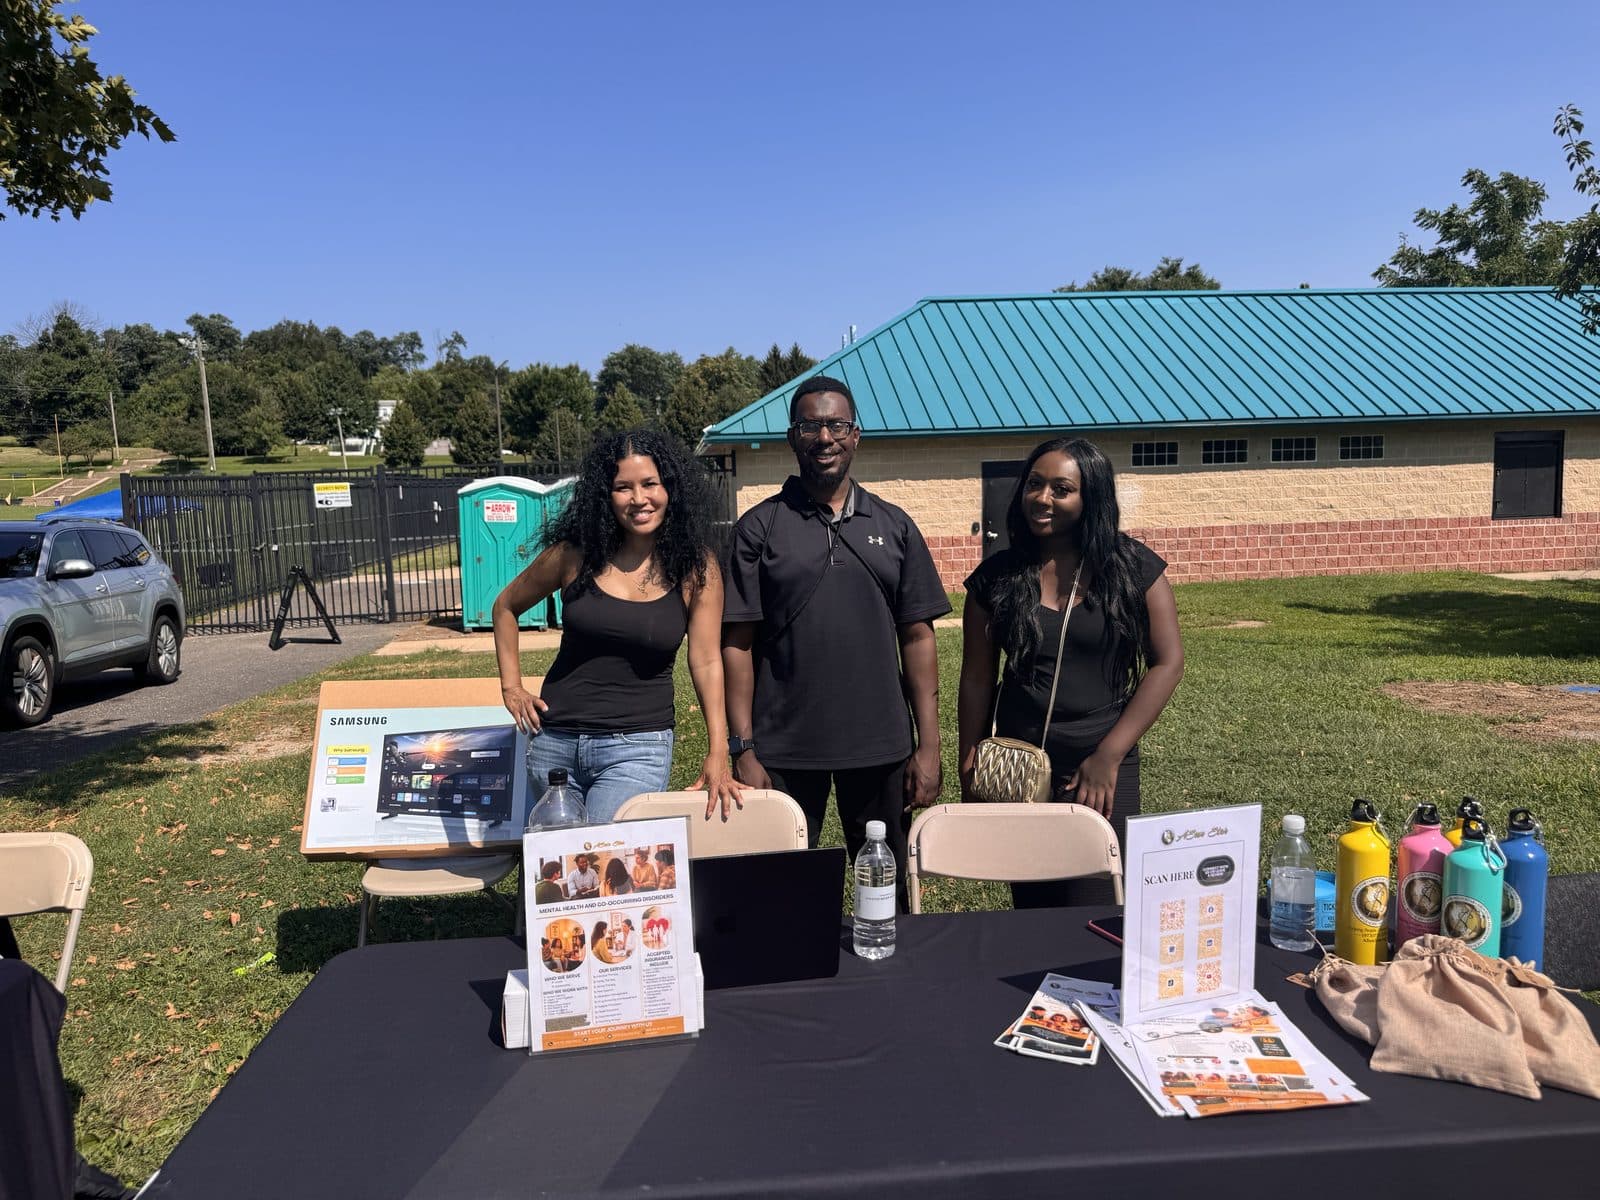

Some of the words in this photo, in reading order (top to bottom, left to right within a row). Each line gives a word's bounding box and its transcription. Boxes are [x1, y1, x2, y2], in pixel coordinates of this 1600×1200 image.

[491, 503, 511, 513] ARROW
[329, 716, 388, 726] SAMSUNG
[1144, 873, 1169, 886] SCAN
[1170, 870, 1195, 882] HERE
[539, 906, 562, 914] MENTAL
[562, 904, 584, 912] HEALTH
[597, 898, 641, 907] CO-OCCURRING
[642, 893, 674, 902] DISORDERS
[573, 1029, 590, 1037] START
[591, 1027, 606, 1035] YOUR
[606, 1024, 629, 1033] JOURNEY
